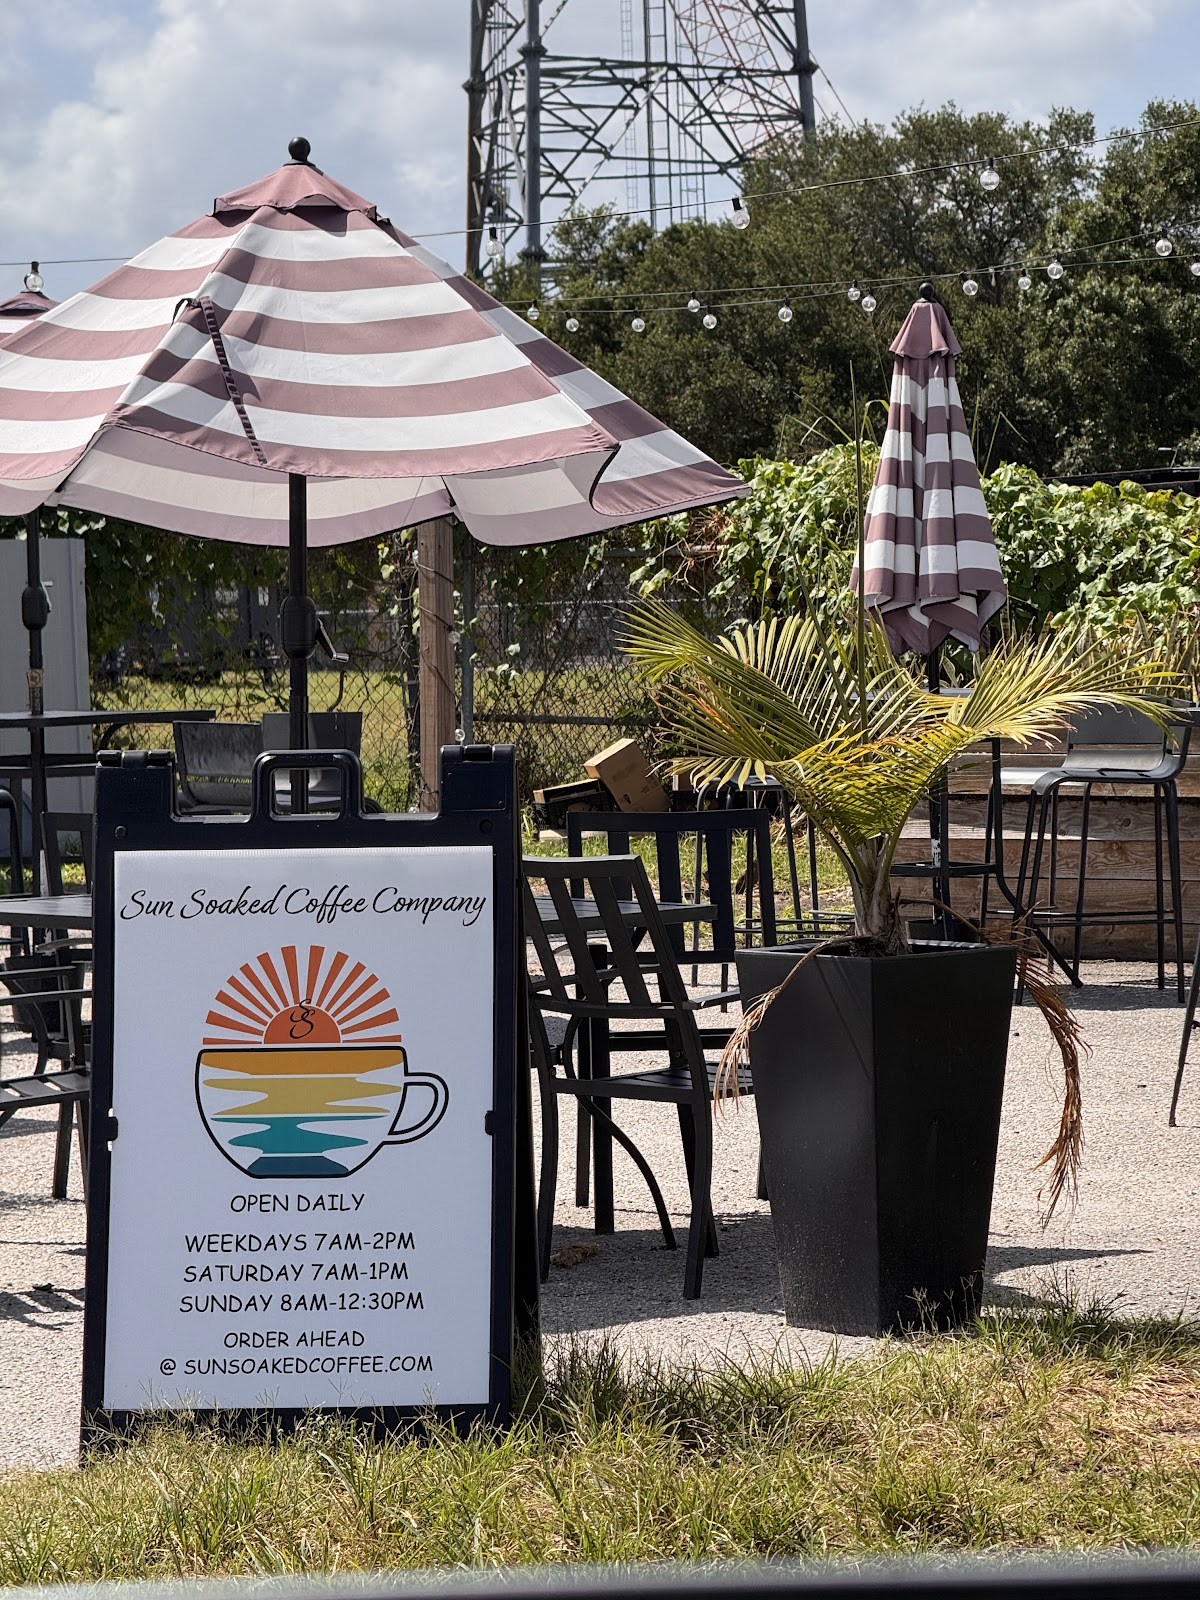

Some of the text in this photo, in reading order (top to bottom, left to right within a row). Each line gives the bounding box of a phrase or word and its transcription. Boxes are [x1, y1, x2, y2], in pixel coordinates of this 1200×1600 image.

[120, 884, 487, 927] Sun Soaked Coffee Company
[230, 1193, 365, 1212] OPEN DAILY
[185, 1231, 416, 1253] WEEKDAYS 7AM-2PM
[183, 1262, 409, 1283] SATURDAY 7AM-1PM
[179, 1292, 425, 1313] SUNDAY 8AM-12:30PM
[223, 1330, 365, 1349] ORDER AHEAD
[159, 1355, 434, 1376] @ SUNSOAKEDCOFFEE.COM
